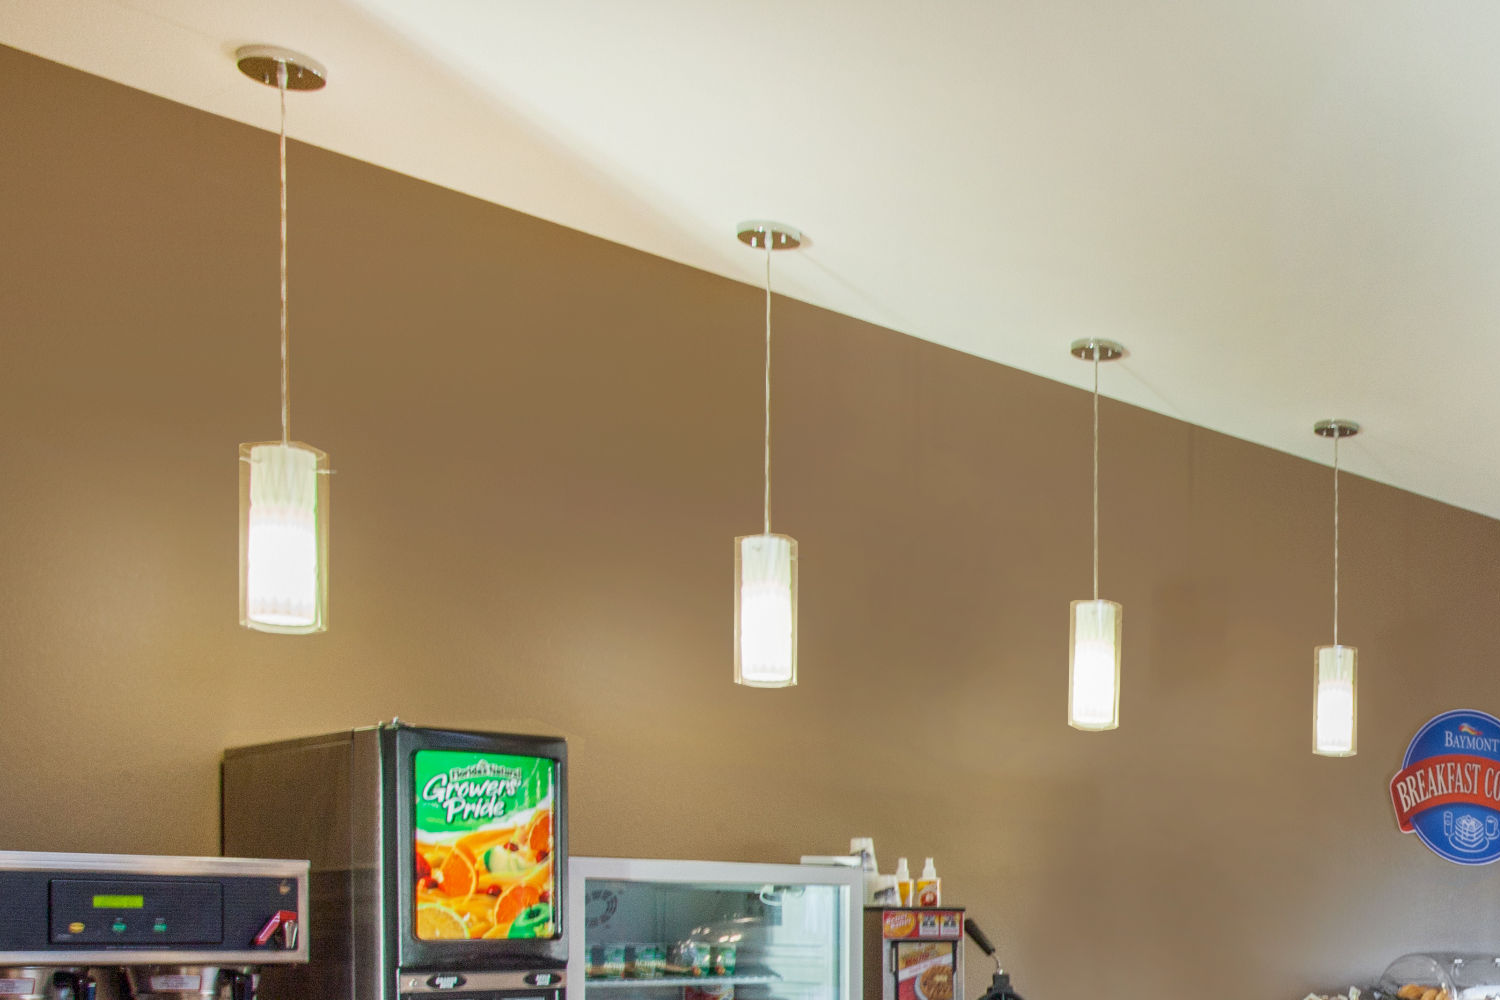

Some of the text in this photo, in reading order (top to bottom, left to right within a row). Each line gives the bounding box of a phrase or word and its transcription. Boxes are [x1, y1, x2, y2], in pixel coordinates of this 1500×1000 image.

[1445, 731, 1499, 752] BAYMONT
[1396, 762, 1481, 813] BREAKFAST
[442, 795, 505, 823] Pride
